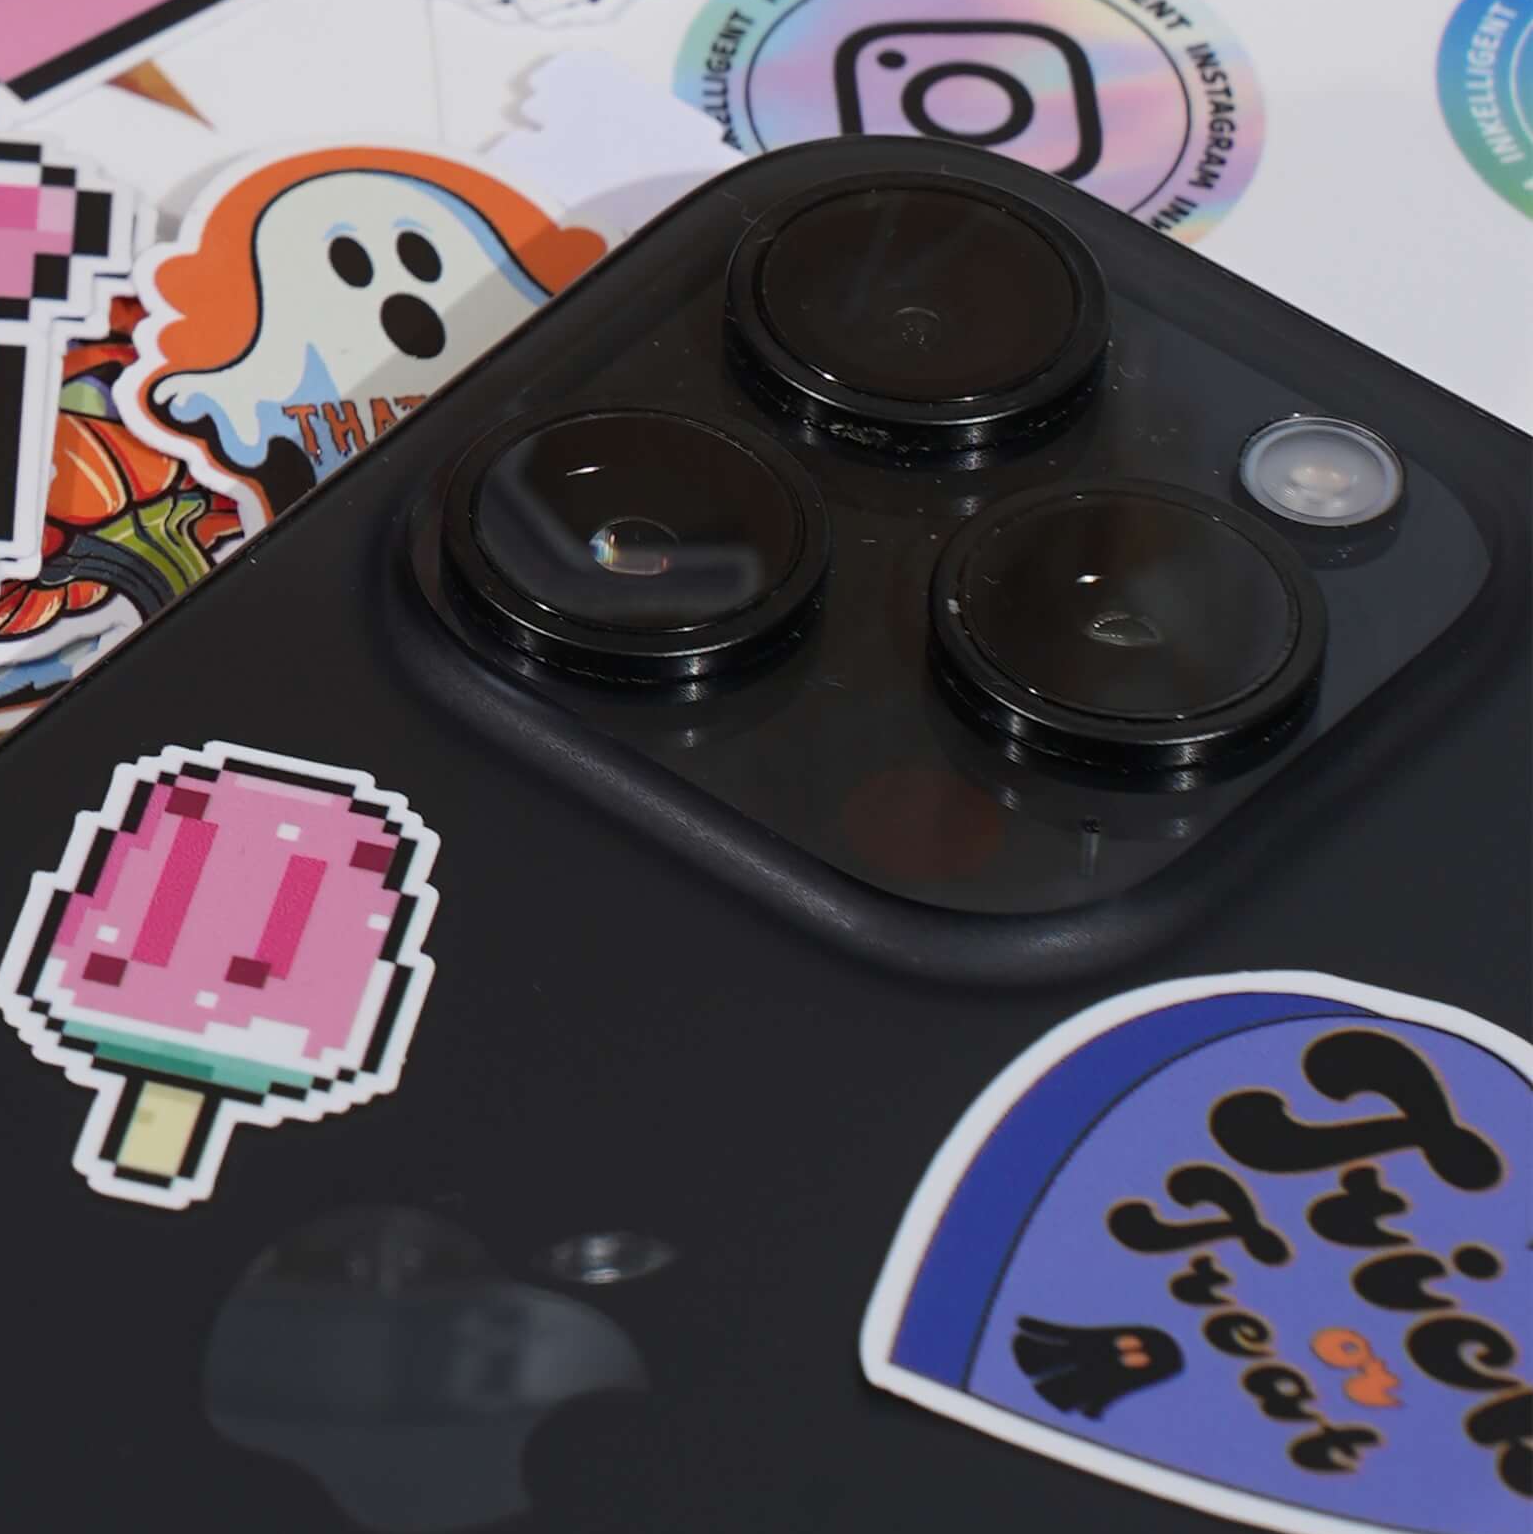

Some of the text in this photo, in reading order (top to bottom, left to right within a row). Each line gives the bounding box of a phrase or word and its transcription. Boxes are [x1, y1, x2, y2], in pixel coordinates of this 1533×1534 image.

[1185, 42, 1237, 191] INSTAGRAM
[1465, 0, 1526, 165] INKELLIGENT
[1104, 1161, 1385, 1475] Treat
